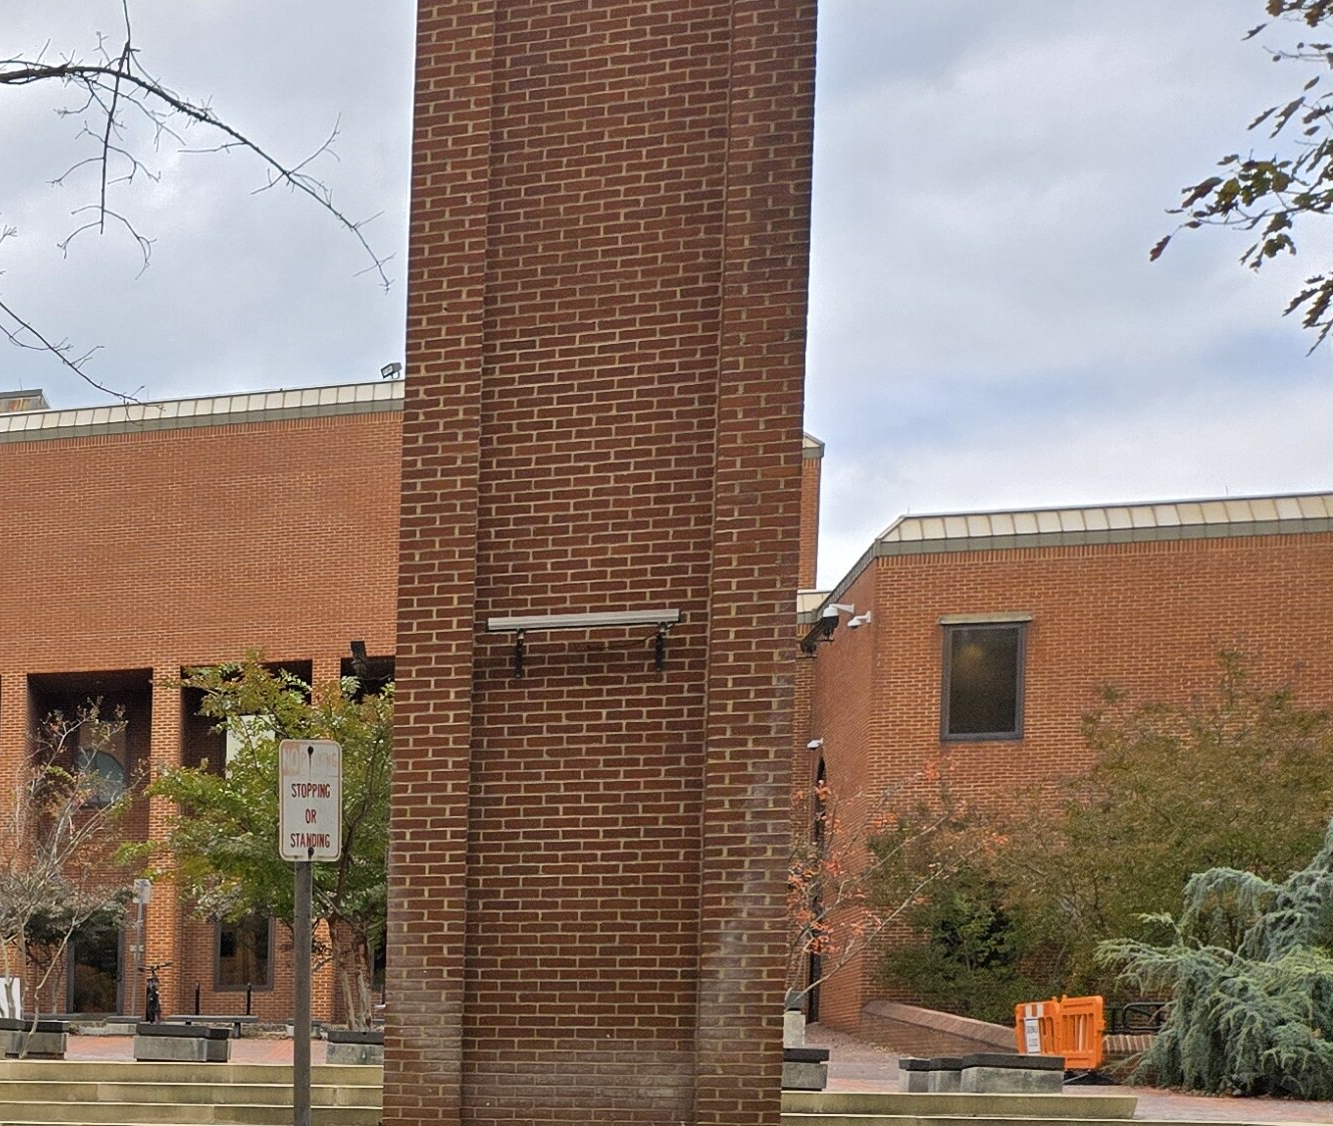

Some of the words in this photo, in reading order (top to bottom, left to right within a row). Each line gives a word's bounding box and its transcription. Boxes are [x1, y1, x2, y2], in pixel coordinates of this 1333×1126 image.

[291, 783, 331, 799] STOPPING
[305, 808, 317, 824] OR
[290, 833, 331, 849] STANDING
